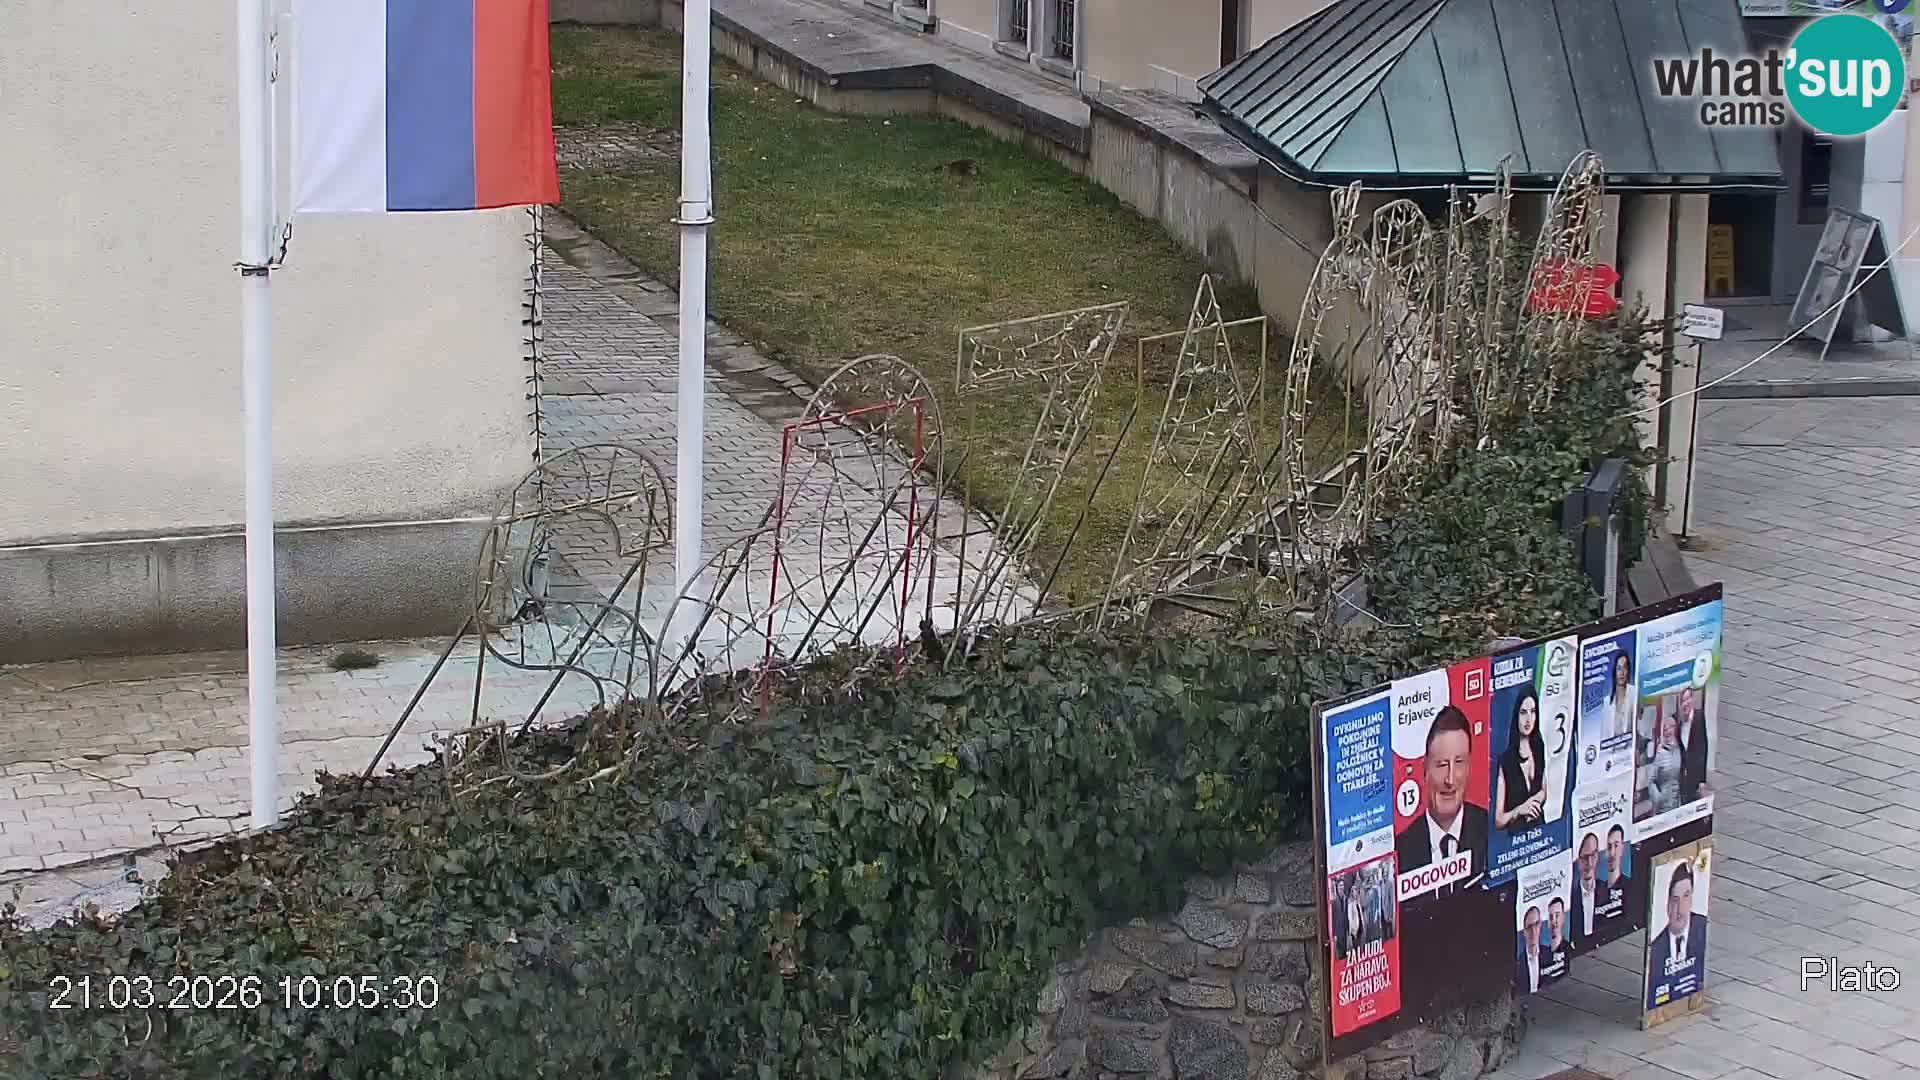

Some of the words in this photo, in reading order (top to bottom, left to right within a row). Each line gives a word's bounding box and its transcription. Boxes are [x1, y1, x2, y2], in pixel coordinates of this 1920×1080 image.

[1468, 679, 1480, 691] SD
[1398, 686, 1432, 709] Andrej
[1367, 711, 1384, 725] SMO
[1398, 707, 1436, 726] Erjavec
[1338, 725, 1381, 747] POKOJNINE
[1336, 751, 1378, 773] POLOŽNICE
[1373, 758, 1384, 771] ZA
[1402, 788, 1416, 807] 13
[1401, 857, 1467, 894] DOGOVOR
[1346, 947, 1357, 968] ZA
[1340, 969, 1352, 987] ZA
[1353, 956, 1389, 984] NARAVO.
[1338, 984, 1373, 1007] SKUPEN
[1373, 972, 1392, 994] BOJ.
